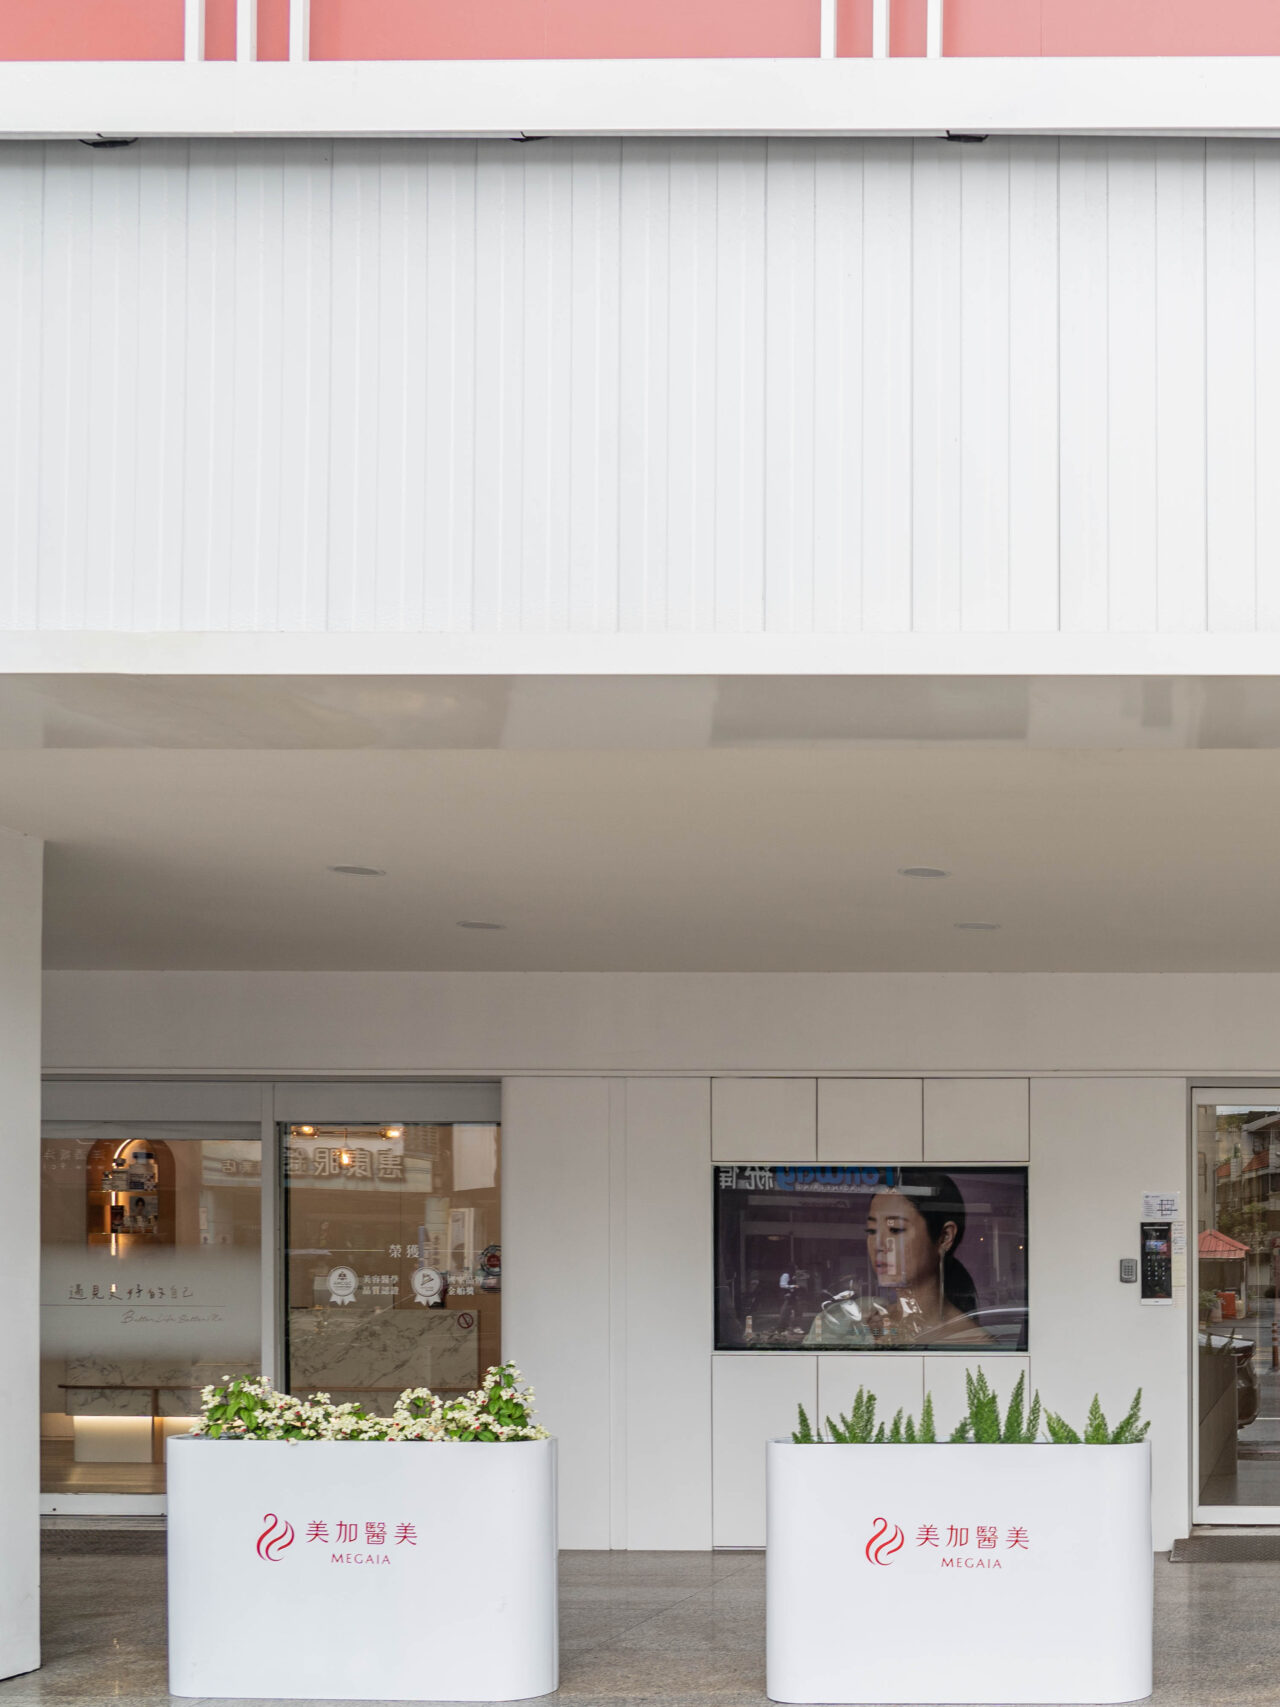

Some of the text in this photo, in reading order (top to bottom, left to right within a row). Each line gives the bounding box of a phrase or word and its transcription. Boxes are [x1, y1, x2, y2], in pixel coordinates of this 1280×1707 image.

[389, 1244, 420, 1259] 榮獲
[305, 1520, 418, 1546] 美加醫美
[915, 1524, 1030, 1550] 美加醫美
[331, 1553, 391, 1565] MEGAIA
[941, 1557, 1003, 1569] MEGAIA
